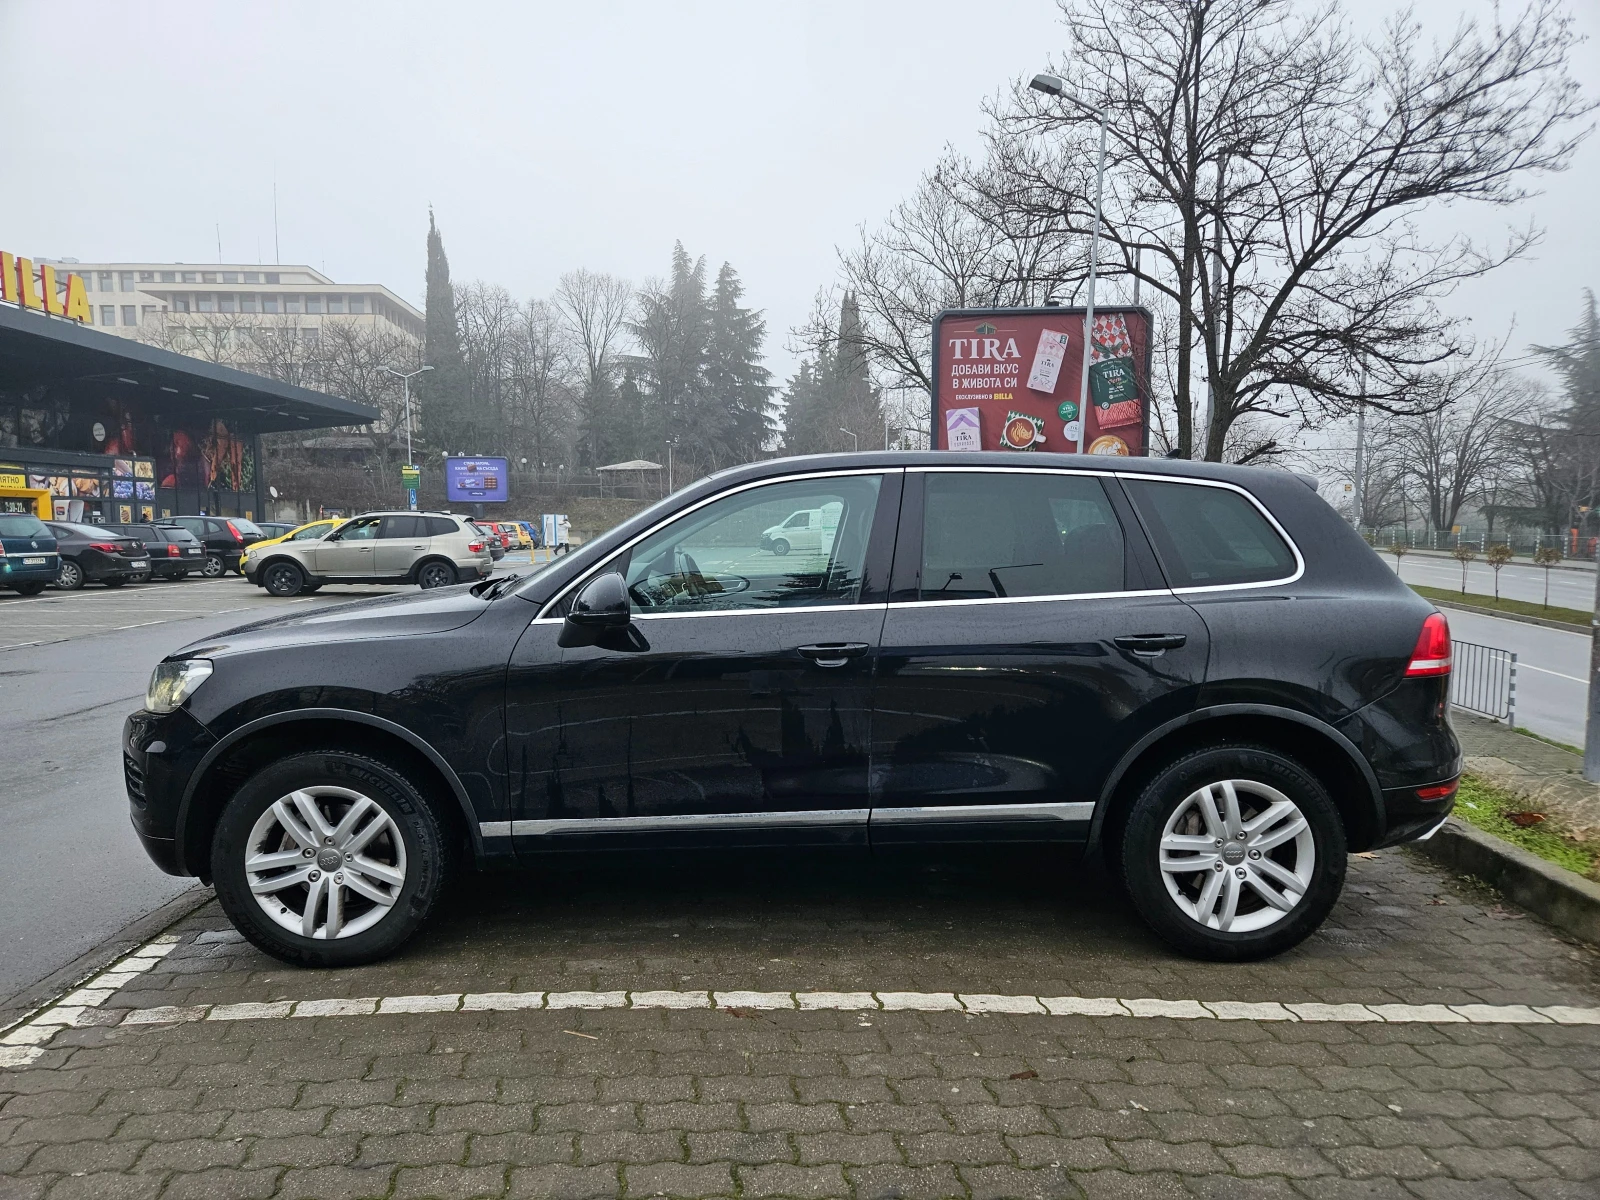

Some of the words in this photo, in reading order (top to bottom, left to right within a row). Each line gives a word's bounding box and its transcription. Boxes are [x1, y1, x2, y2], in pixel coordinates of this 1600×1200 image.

[949, 338, 1022, 361] TIRA
[951, 364, 991, 376] ДОБАВИ
[994, 363, 1019, 374] ВКУС
[1103, 368, 1125, 379] TIRA
[952, 378, 959, 389] В
[962, 378, 1001, 389] ЖИВОТА
[1004, 377, 1017, 388] СИ
[994, 392, 1013, 400] BILLA
[349, 768, 412, 814] MICHELIN
